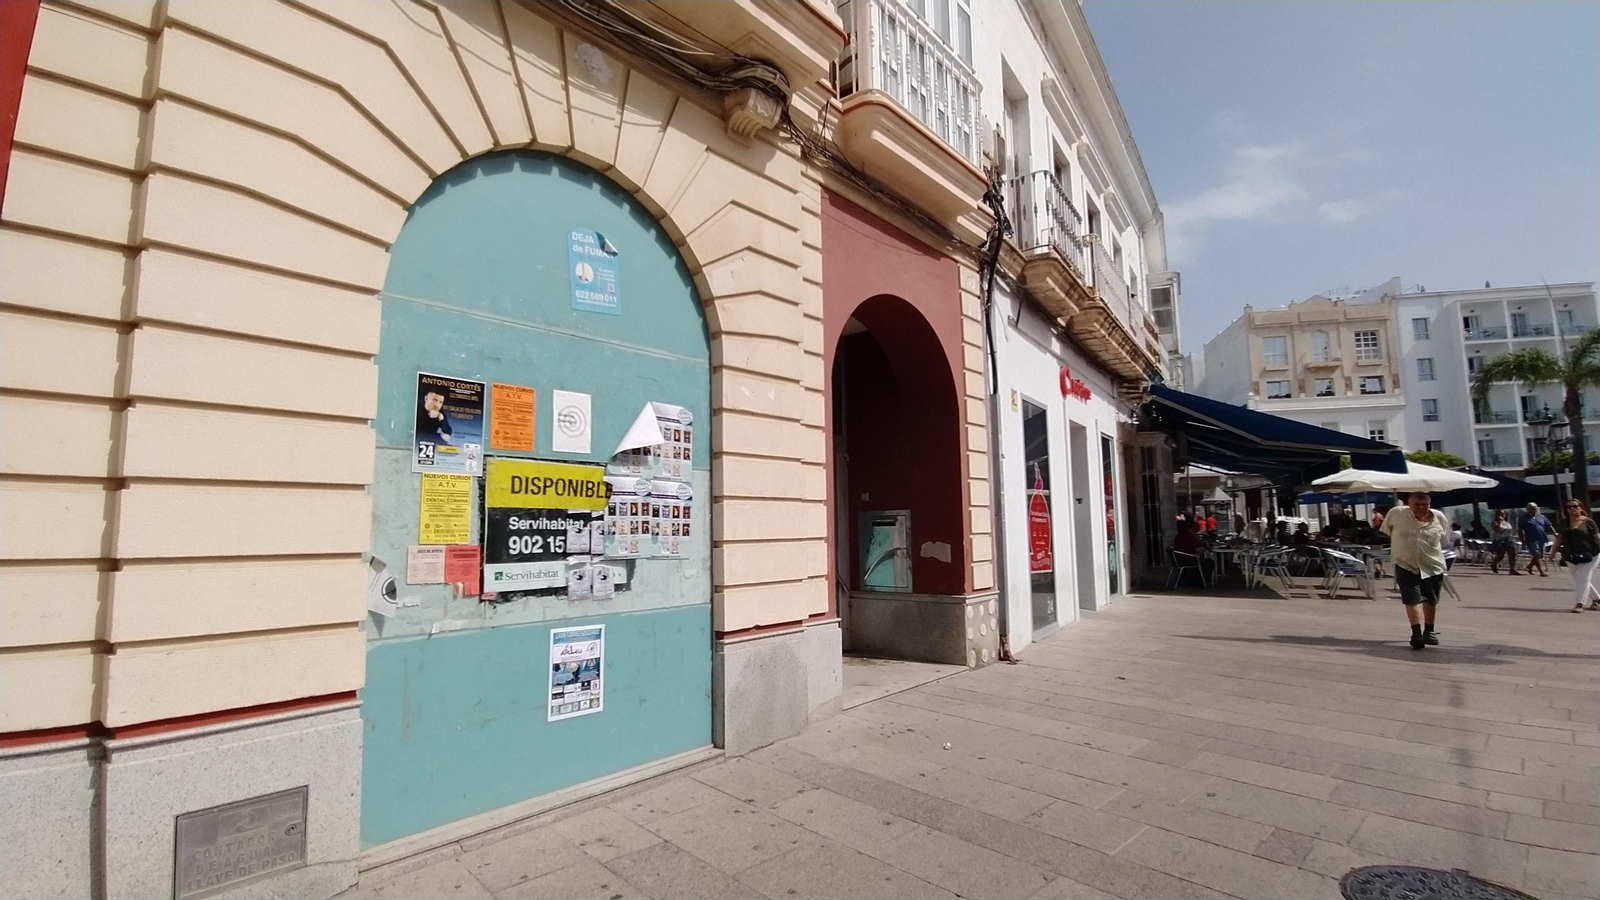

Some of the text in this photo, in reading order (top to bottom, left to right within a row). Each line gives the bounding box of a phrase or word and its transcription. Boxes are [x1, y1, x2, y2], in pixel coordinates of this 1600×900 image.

[572, 232, 594, 243] DEJA
[572, 244, 583, 252] de
[575, 290, 590, 299] 622
[422, 377, 455, 388] ANTONIO
[456, 382, 481, 392] CORTÉS
[418, 444, 434, 458] 24
[511, 475, 613, 499] DISPONIBLE
[508, 516, 585, 531] Servihabitat
[508, 535, 543, 555] 902
[547, 535, 565, 553] 15
[505, 569, 559, 581] Servihabitat
[192, 832, 275, 861] CONTADOR
[196, 846, 271, 876] DE AGUA
[187, 852, 296, 891] LLAVE DE PASO
